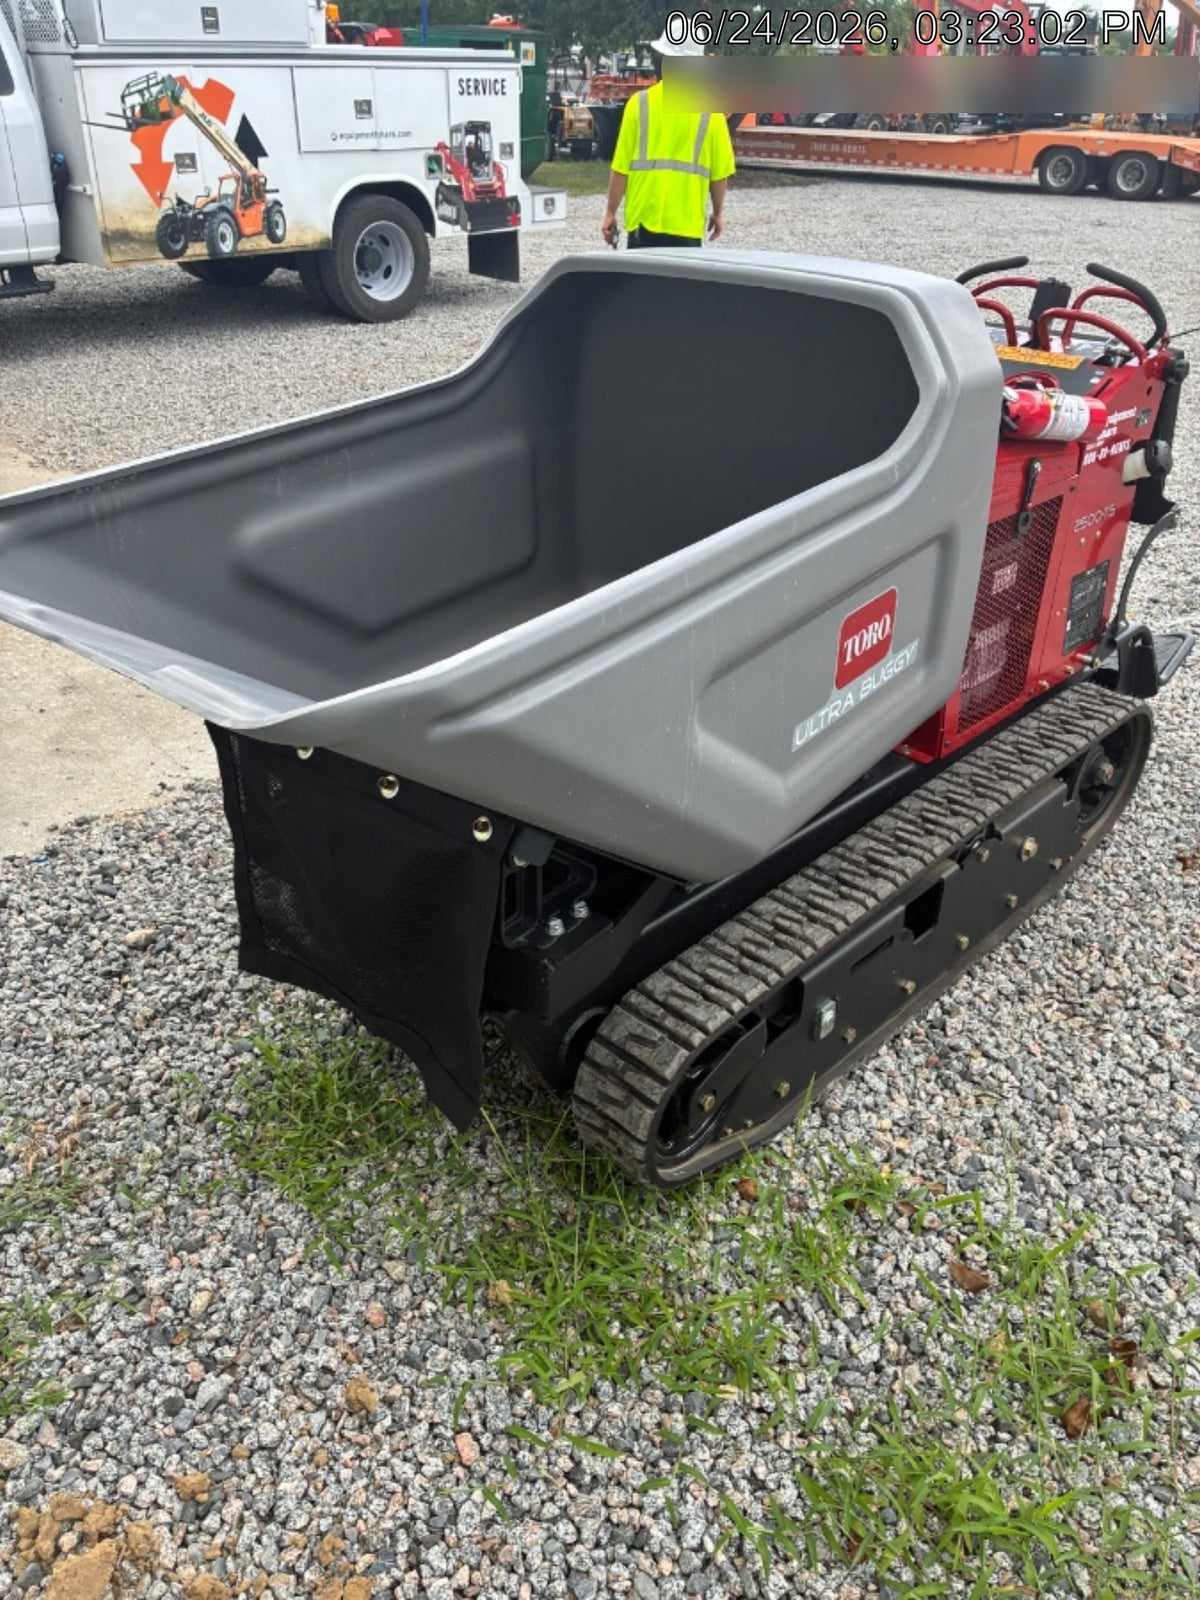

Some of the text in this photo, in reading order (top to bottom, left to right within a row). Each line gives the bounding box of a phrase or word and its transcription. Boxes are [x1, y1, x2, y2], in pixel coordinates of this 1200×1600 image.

[458, 78, 507, 96] SERVICE
[339, 130, 412, 141] equipmentshare.com
[843, 613, 891, 666] TORO
[795, 691, 855, 746] ULTRA
[860, 648, 915, 700] BUGGY
